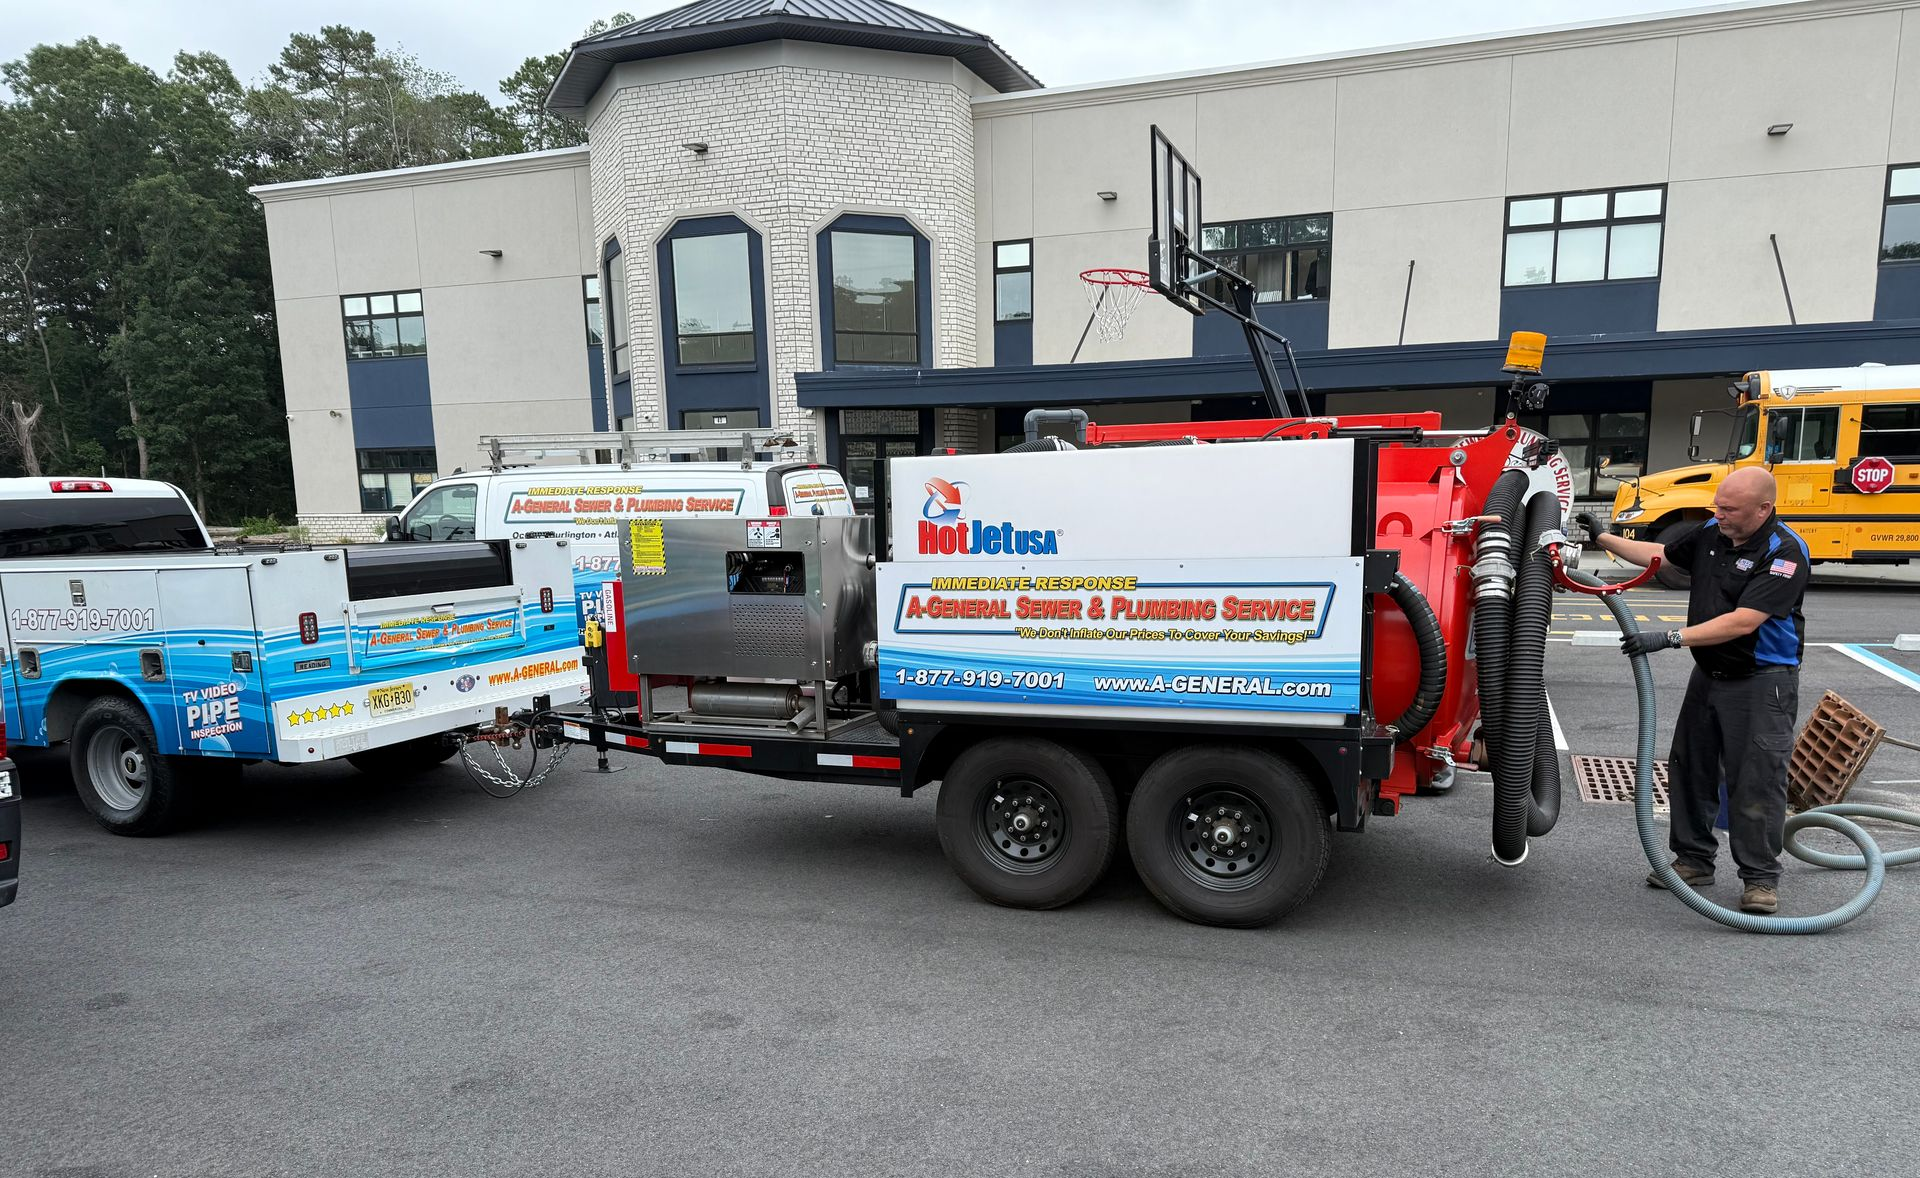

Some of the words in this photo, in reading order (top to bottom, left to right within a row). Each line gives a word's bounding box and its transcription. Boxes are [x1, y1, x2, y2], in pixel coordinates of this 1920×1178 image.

[1857, 468, 1889, 482] STOP
[528, 487, 585, 496] IMMEDIATE
[586, 485, 643, 495] RESPONSE
[511, 498, 572, 513] A-GENERAL
[574, 497, 611, 513] SEWER
[614, 496, 624, 512] &
[626, 497, 683, 512] PLUMBING
[686, 496, 735, 512] SERVICE
[551, 531, 596, 540] urlington
[604, 531, 619, 539] Atl
[1623, 528, 1635, 539] 104
[1871, 534, 1894, 542] GVWR
[1895, 534, 1919, 543] 29,800
[576, 556, 620, 572] 1-877
[931, 577, 1031, 591] IMMEDIATE
[1035, 577, 1136, 591] RESPONSE
[579, 591, 592, 600] TV
[582, 599, 602, 615] PI
[605, 589, 613, 626] GASOLINE
[906, 595, 1011, 619] A-GENERAL
[1015, 595, 1082, 620] SEWER
[1087, 595, 1105, 619] &
[1111, 596, 1216, 620] PLUMBING
[1221, 595, 1316, 620] SERVICE
[12, 608, 154, 631] 1-877-919-7001
[370, 632, 413, 646] A-GENERAL
[416, 628, 440, 640] SEWER
[443, 624, 448, 636] &
[451, 623, 484, 636] PLUMBING
[487, 618, 513, 630] SERVICE
[1015, 627, 1036, 639] "We
[1039, 627, 1067, 639] Don't
[1070, 628, 1103, 640] Inflate
[1105, 628, 1127, 640] Our
[1129, 628, 1165, 640] Prices
[1168, 629, 1182, 640] To
[1185, 629, 1220, 640] Cover
[1223, 629, 1250, 641] Your
[1253, 629, 1316, 644] Savings!"
[895, 668, 1065, 689] 1-877-919-7001
[1094, 675, 1331, 697] www.A-GENERAL.com
[183, 691, 198, 704] TV
[201, 682, 237, 701] VIDEO
[187, 696, 241, 728] PIPE
[191, 721, 243, 740] INSPECTION
